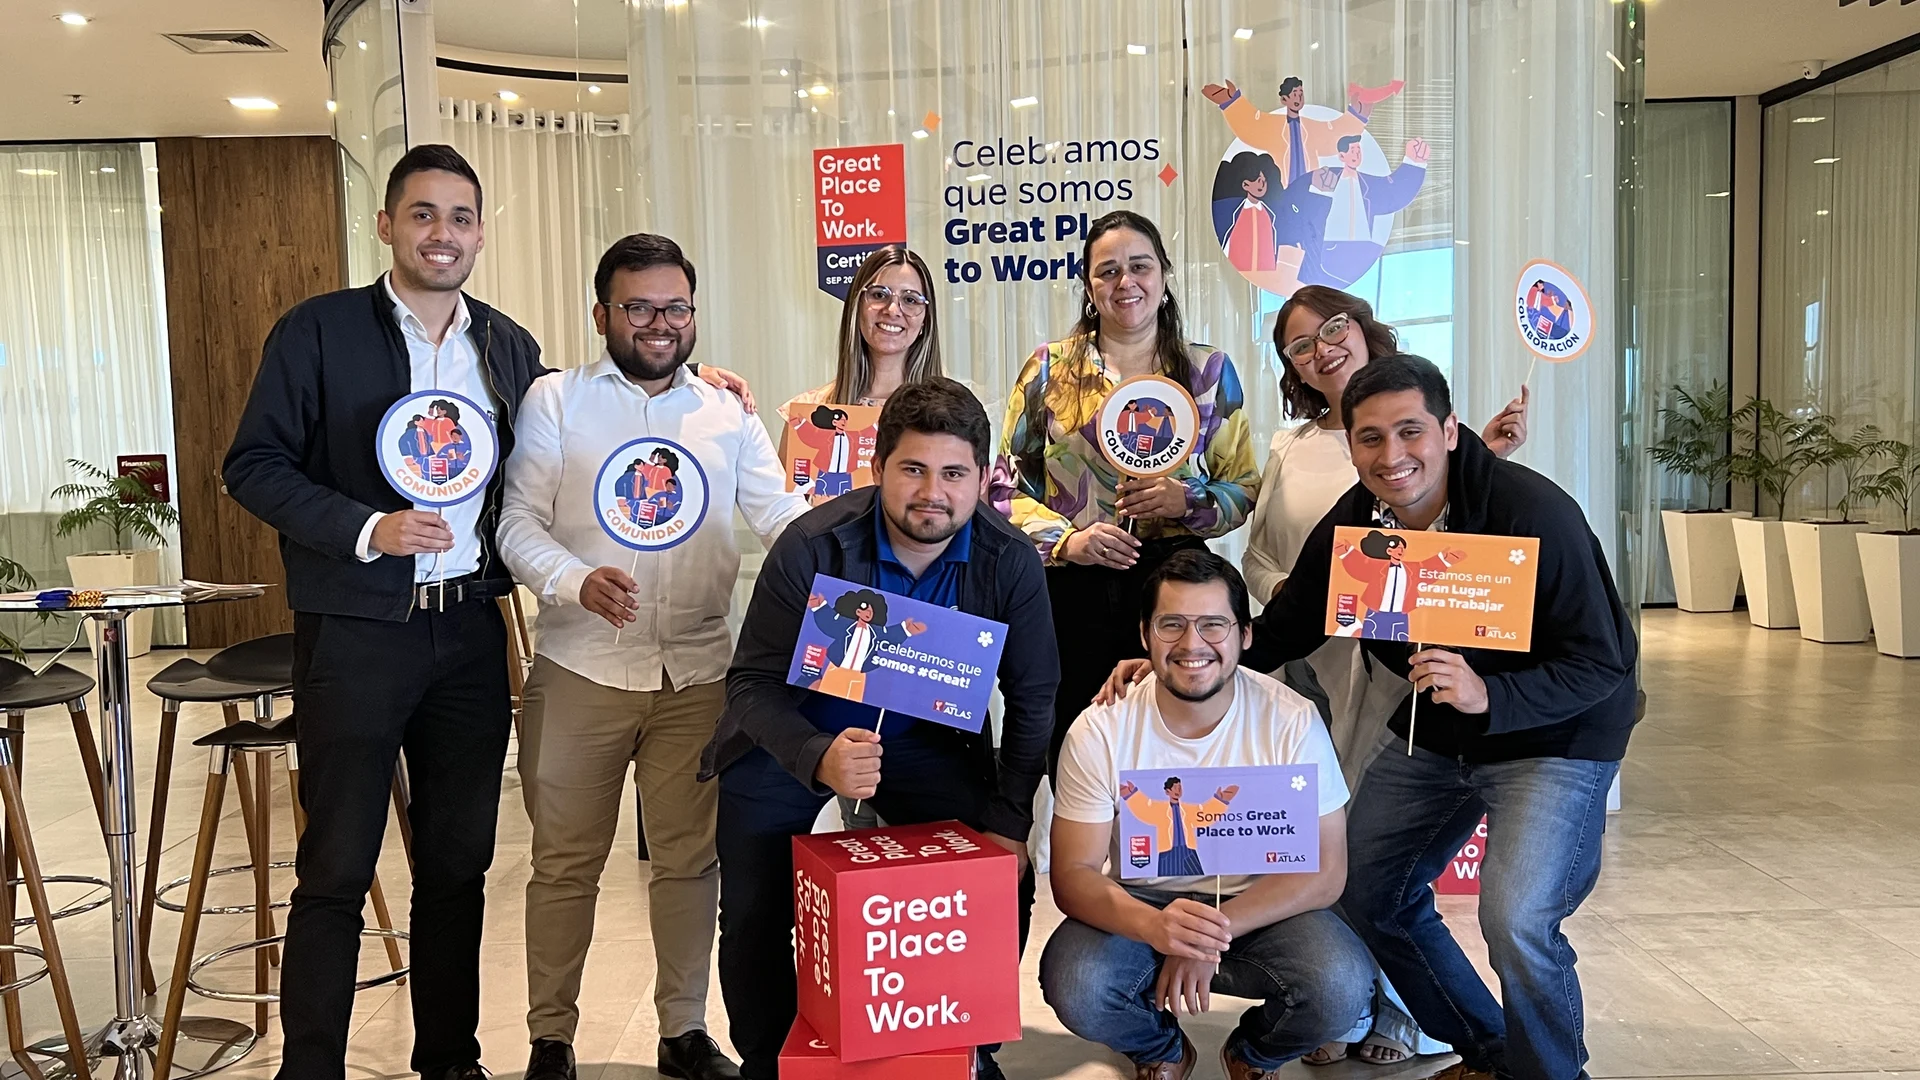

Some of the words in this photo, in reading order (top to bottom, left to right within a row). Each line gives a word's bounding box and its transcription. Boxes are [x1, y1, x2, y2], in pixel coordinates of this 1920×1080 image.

[819, 153, 881, 174] Great
[822, 176, 881, 196] Place
[944, 181, 1008, 213] que
[1019, 176, 1134, 204] somos
[820, 199, 844, 217] To
[944, 216, 1046, 245] Great
[826, 276, 842, 285] SEP
[944, 258, 982, 284] to
[991, 252, 1085, 282] Work
[1518, 297, 1580, 352] COLABORACIÓN
[1105, 430, 1186, 469] COLABORACIÓN
[395, 467, 480, 497] COMUNIDAD
[606, 508, 685, 541] COMUNIDAD
[1419, 568, 1473, 583] Estamos
[1475, 573, 1493, 583] en
[1494, 574, 1511, 584] un
[1417, 582, 1450, 594] Gran
[1452, 584, 1491, 598] Lugar
[1416, 598, 1445, 609] para
[1448, 598, 1504, 613] Trabajar
[1486, 630, 1517, 640] ATLAS
[871, 655, 915, 675] somos
[918, 668, 971, 688] #Great!
[875, 640, 955, 669] ¡Celebramos
[957, 663, 982, 677] que
[943, 706, 972, 720] ATLAS
[1196, 811, 1243, 822] Somos
[1246, 809, 1287, 821] Great
[1196, 826, 1235, 837] Place
[1239, 825, 1253, 836] to
[1257, 824, 1296, 836] Work
[832, 838, 880, 864] Great
[870, 835, 915, 860] Place
[919, 844, 947, 857] To
[1278, 854, 1306, 863] ATLAS
[804, 876, 812, 913] To
[862, 889, 968, 926] Great
[812, 882, 821, 985] Place
[821, 888, 832, 997] Great
[866, 928, 967, 962] Place
[864, 967, 904, 997] To
